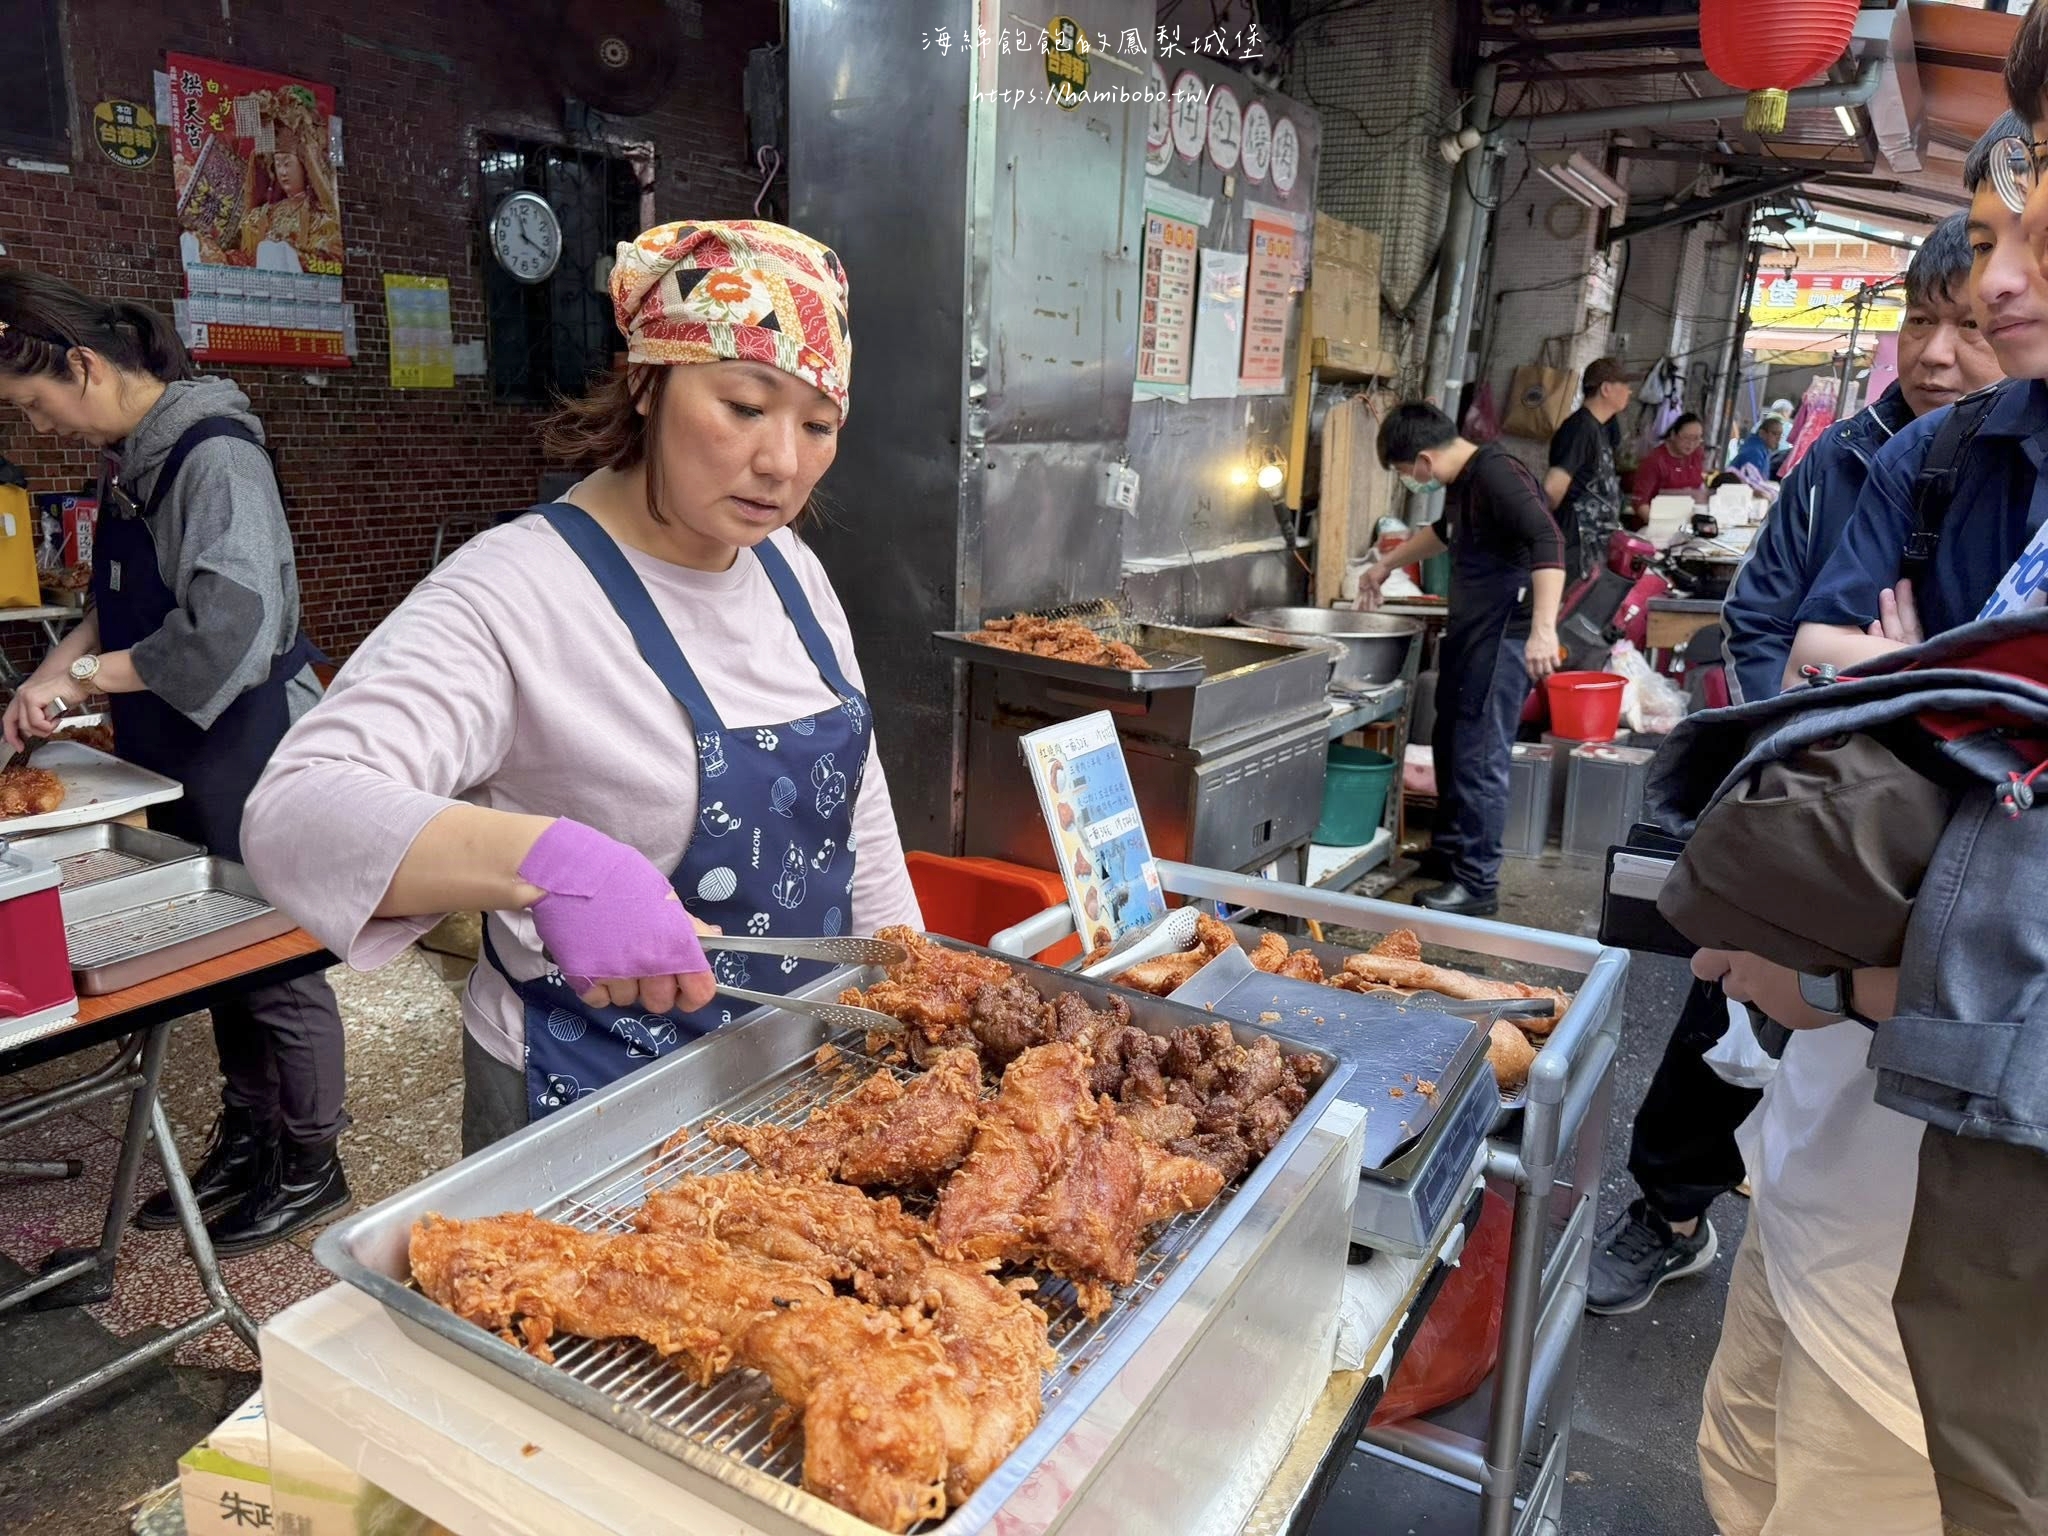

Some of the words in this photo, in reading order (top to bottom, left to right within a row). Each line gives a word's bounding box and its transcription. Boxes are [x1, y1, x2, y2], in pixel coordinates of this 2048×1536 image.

[1047, 46, 1085, 85] 台灣豬
[115, 105, 132, 116] 本店
[99, 122, 152, 149] 台灣豬
[108, 148, 133, 166] TAIWAN
[308, 257, 343, 275] 2026
